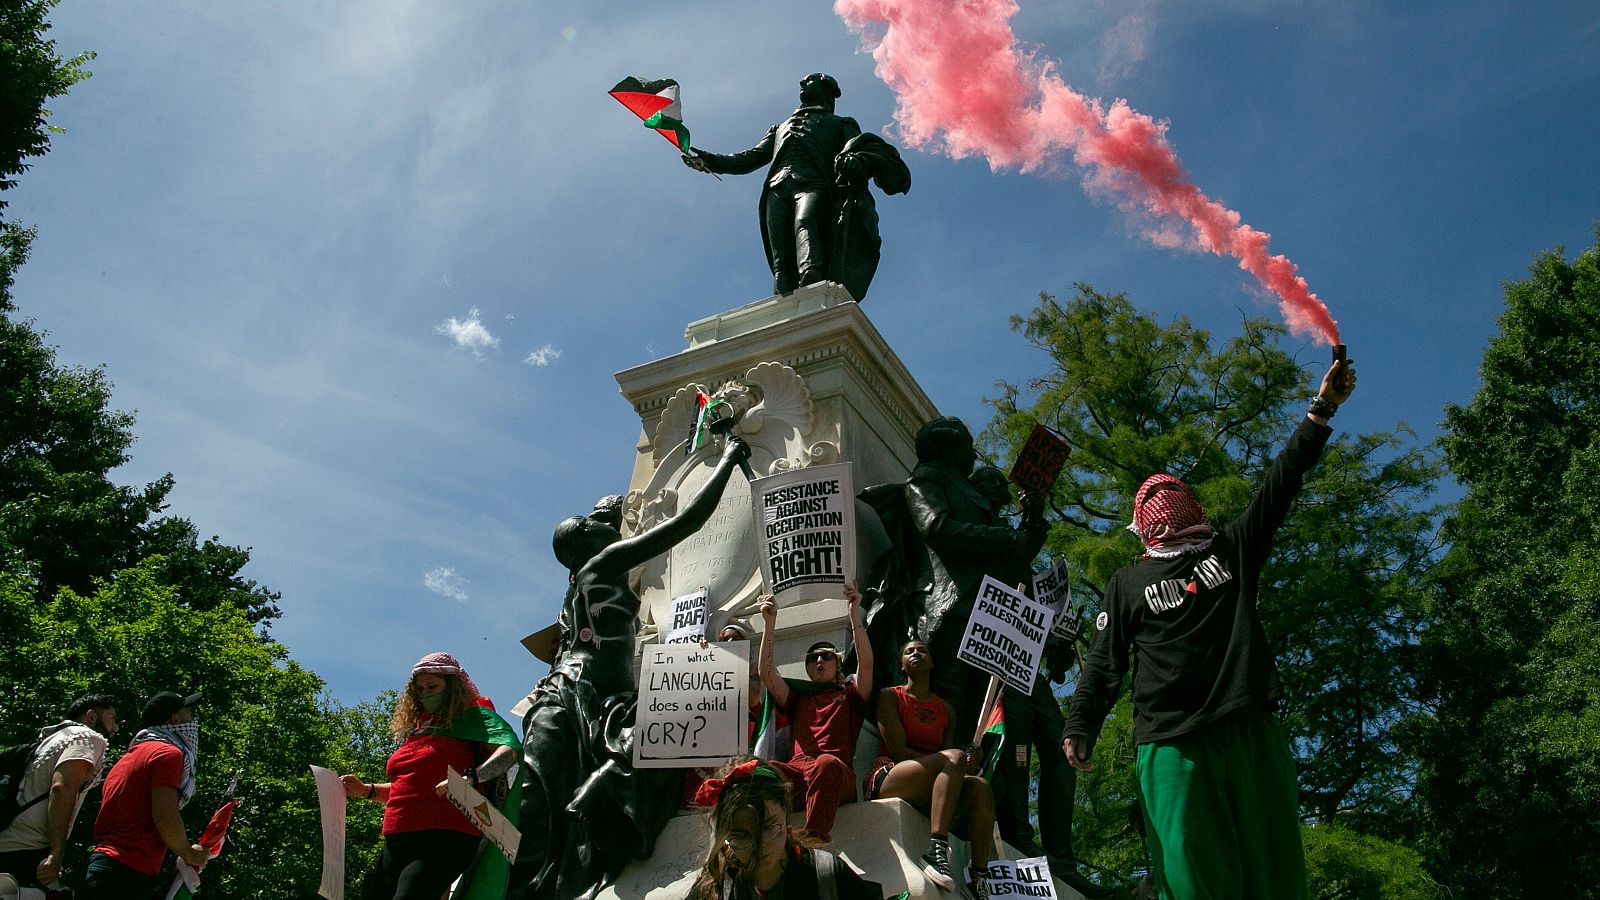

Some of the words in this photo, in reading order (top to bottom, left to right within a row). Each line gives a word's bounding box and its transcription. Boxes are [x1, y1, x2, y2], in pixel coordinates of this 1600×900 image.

[764, 480, 840, 507] RESISTANCE
[776, 497, 829, 519] AGAINST
[766, 511, 843, 538] OCCUPATION
[768, 542, 780, 557] IS
[781, 537, 790, 552] A
[792, 531, 842, 550] HUMAN
[770, 547, 843, 584] RIGHT!
[982, 583, 1021, 614] FREE
[1020, 605, 1045, 631] ALL
[978, 600, 1043, 644] PALESTINIAN
[654, 652, 674, 664] In
[688, 651, 716, 662] what
[970, 622, 1034, 669] POLITICAL
[965, 638, 1032, 682] PRISONERS
[649, 672, 735, 691] LANGUAGE
[649, 697, 680, 711] does
[697, 696, 727, 711] child
[647, 715, 707, 748] CRY?
[987, 865, 1014, 880] EE
[1016, 864, 1048, 883] ALL
[989, 882, 1052, 897] LESTINIAN
